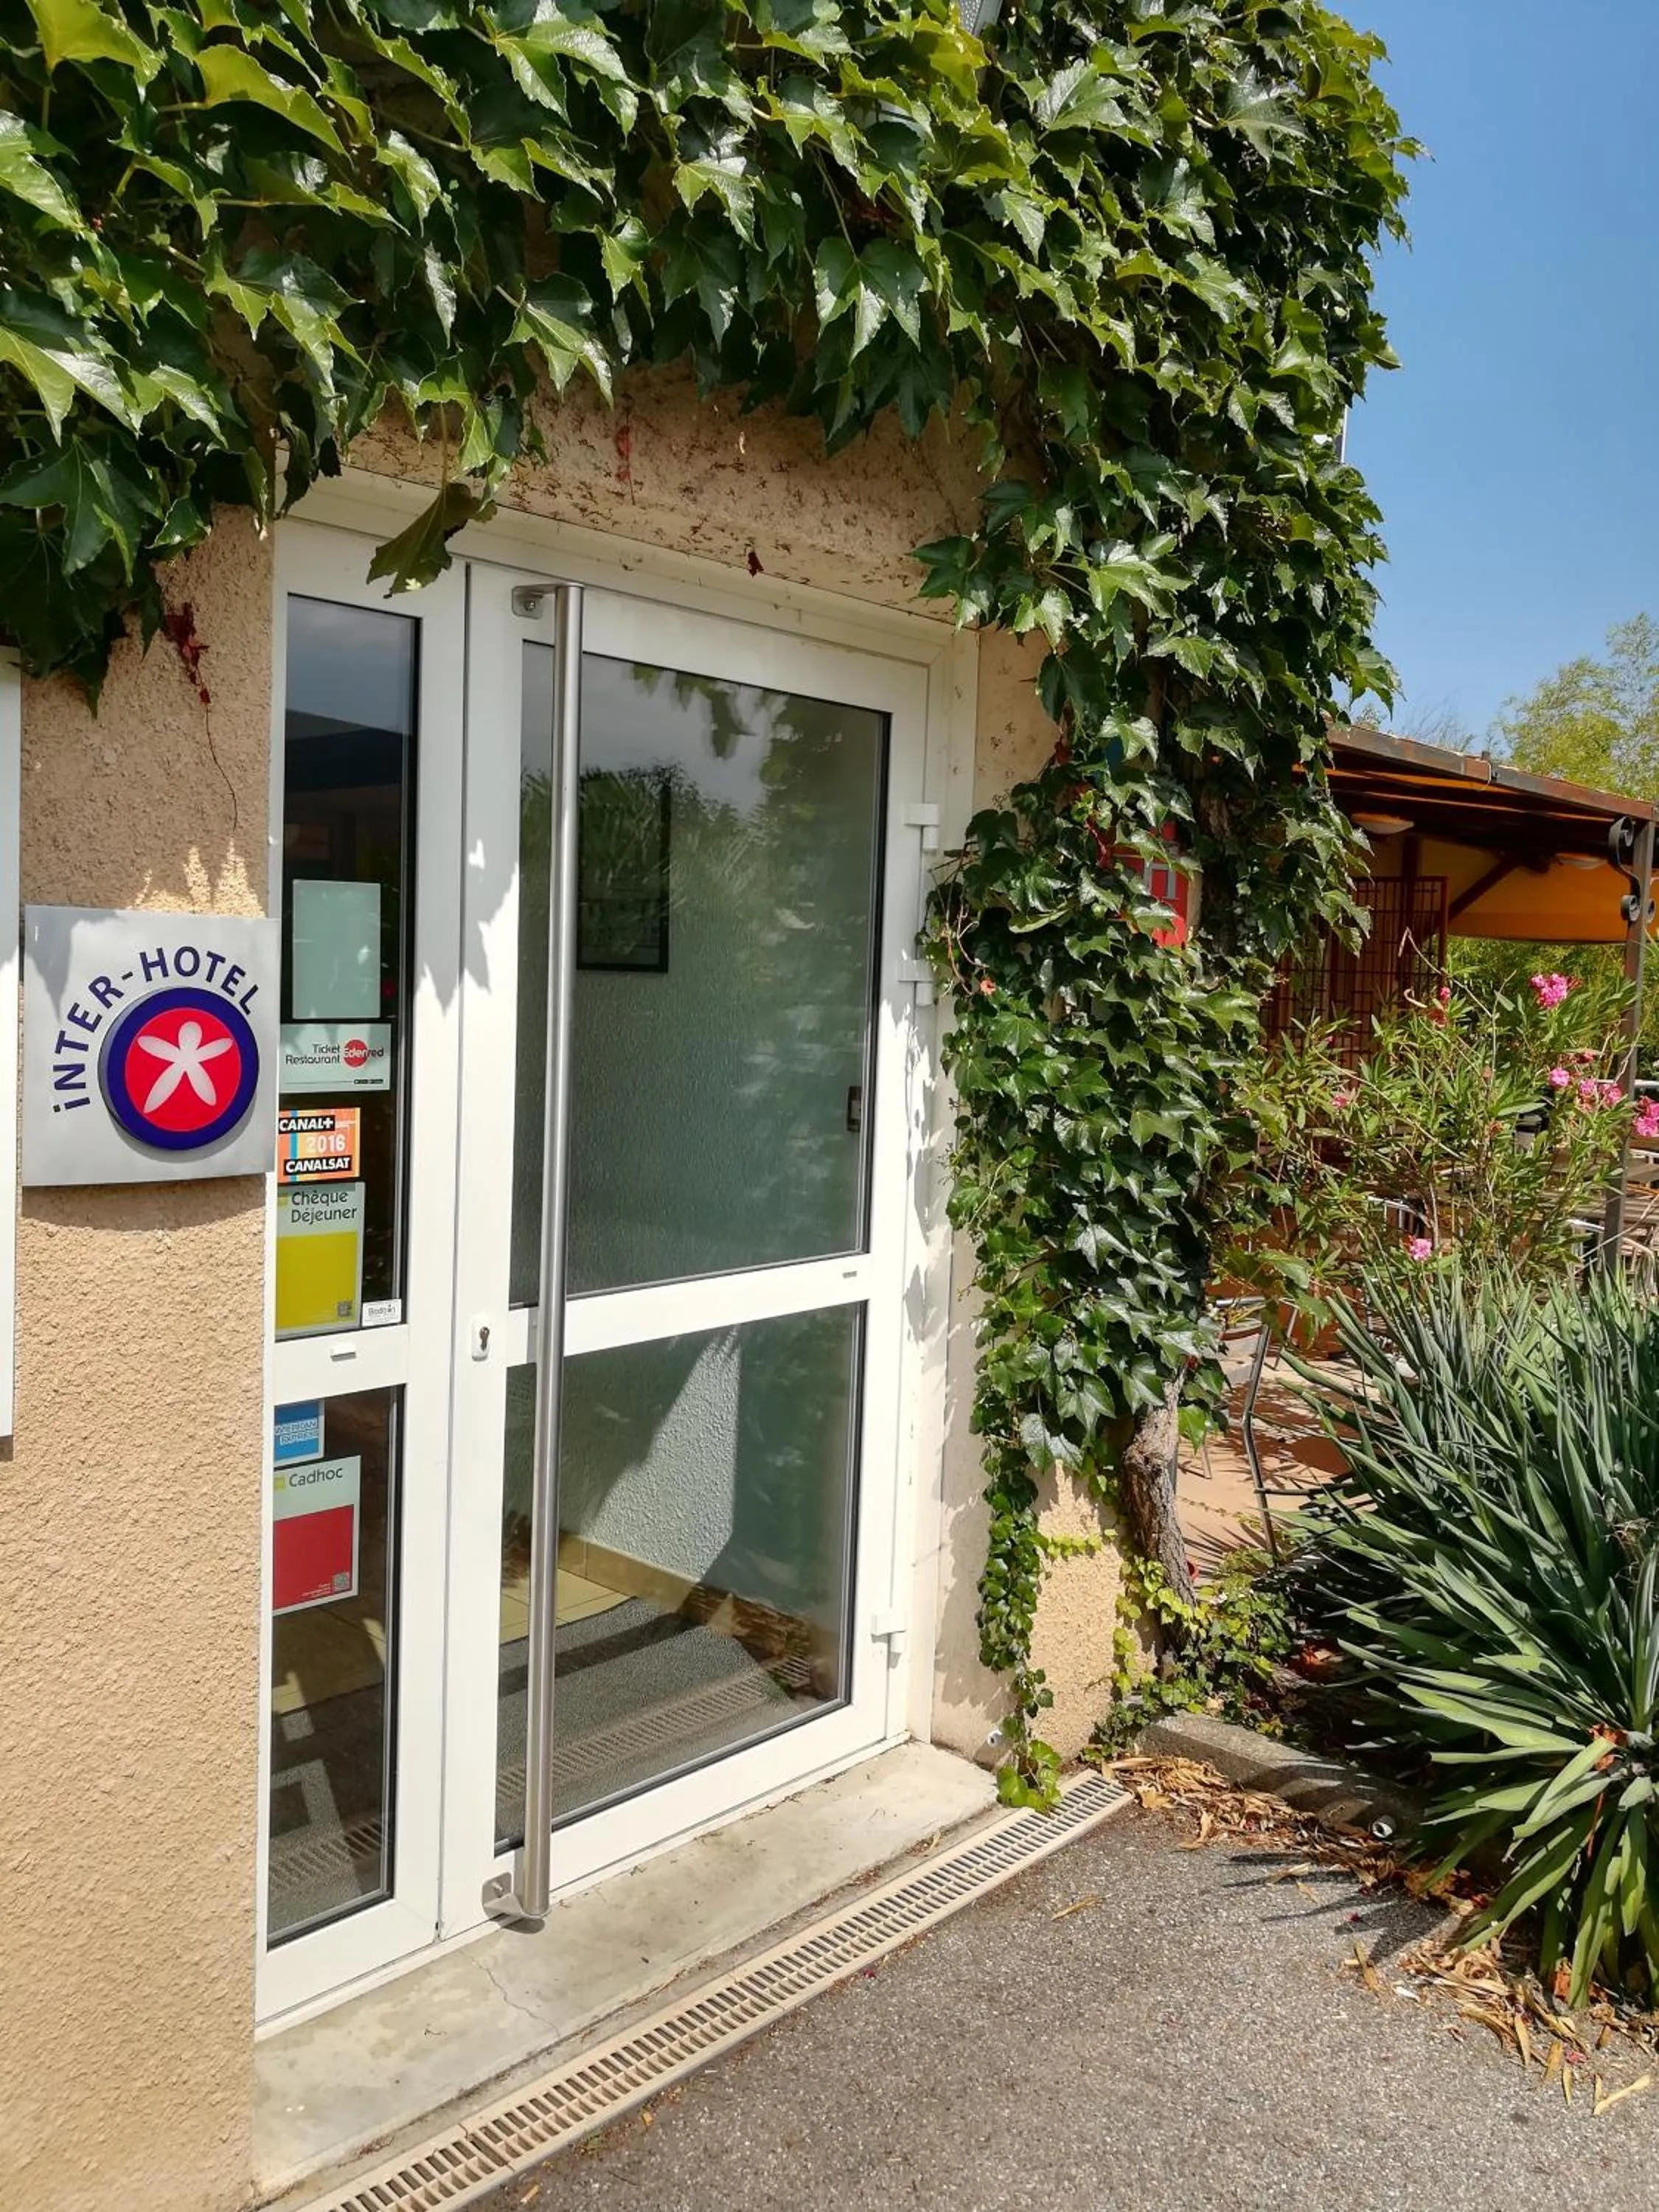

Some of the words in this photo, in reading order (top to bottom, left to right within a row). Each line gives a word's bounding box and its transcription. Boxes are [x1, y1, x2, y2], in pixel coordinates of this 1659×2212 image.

[313, 1043, 340, 1054] Ticket
[344, 1046, 384, 1058] Edenred
[285, 1054, 340, 1065] Restaurant
[279, 1117, 334, 1132] CANAL+
[306, 1134, 346, 1154] 2016
[285, 1157, 350, 1173] CANALSAT
[291, 1189, 348, 1206] Chèque
[291, 1208, 358, 1225] Déjeuner
[289, 1467, 343, 1487] Cadhoc
